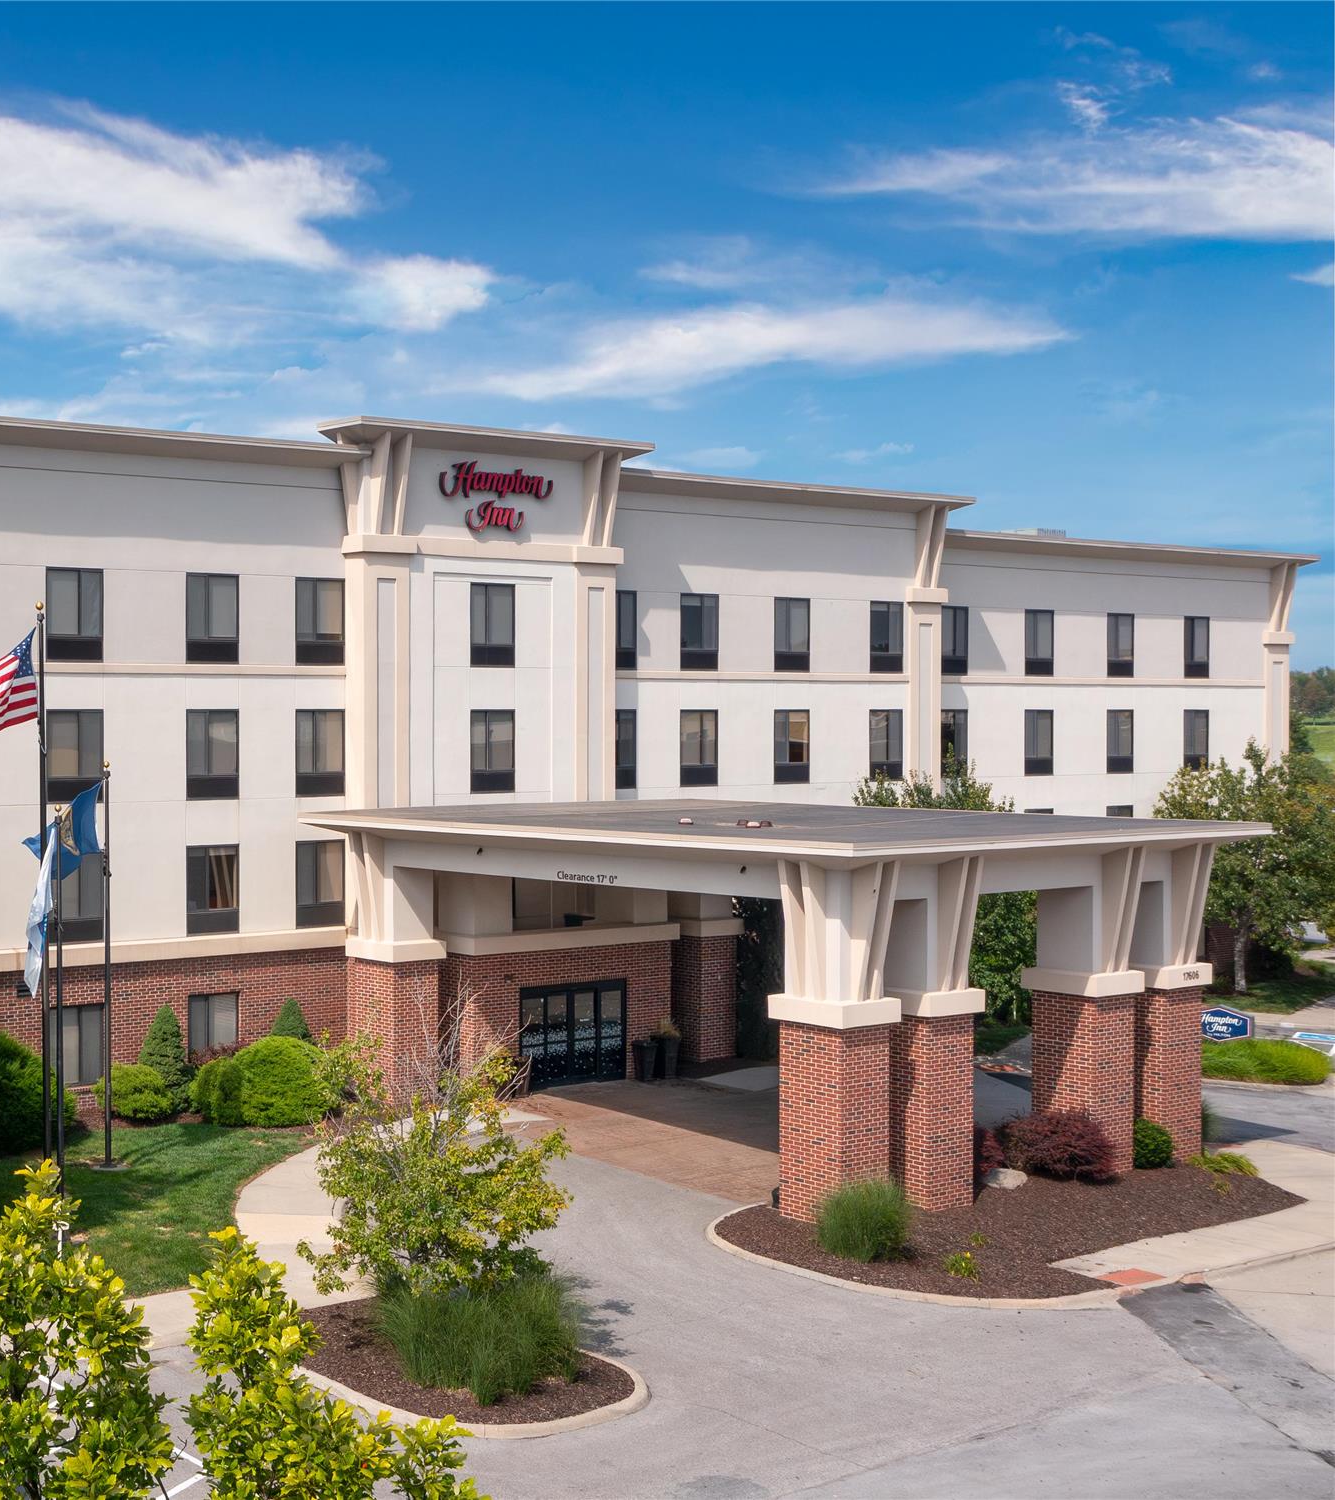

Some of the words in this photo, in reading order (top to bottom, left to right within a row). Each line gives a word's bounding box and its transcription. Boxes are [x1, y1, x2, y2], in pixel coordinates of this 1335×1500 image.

[439, 460, 553, 499] Hampton
[465, 500, 524, 532] Inn
[556, 870, 595, 883] Clearance
[1183, 970, 1200, 981] 17606
[1201, 1013, 1242, 1026] Hampton
[1206, 1023, 1232, 1033] Inn
